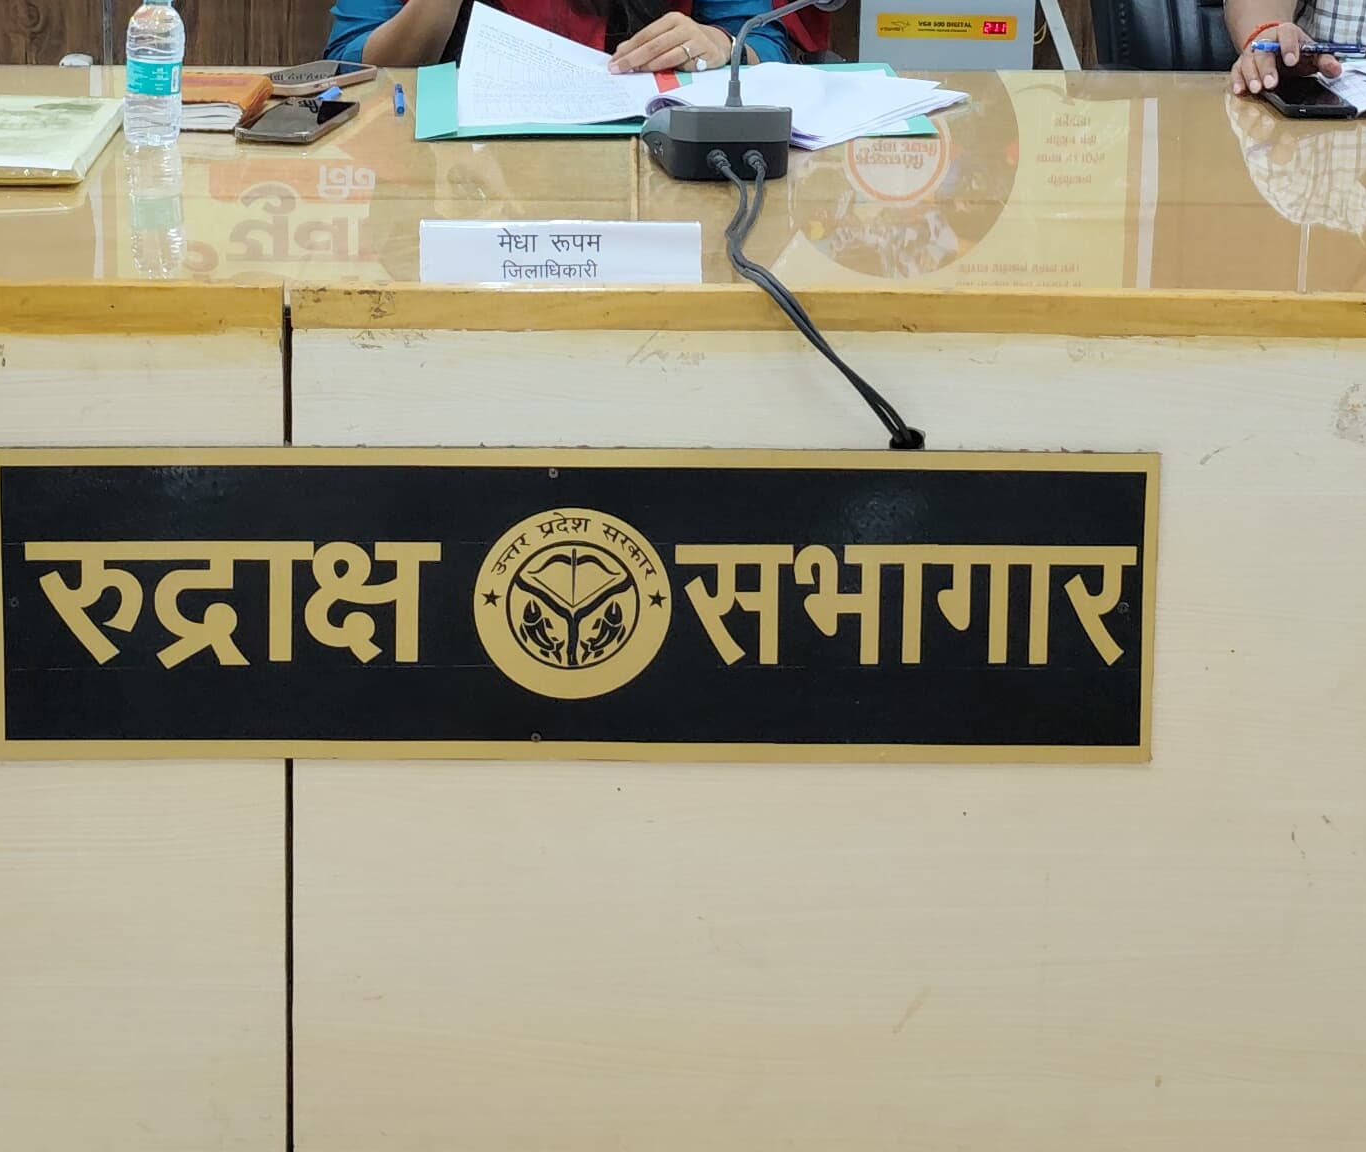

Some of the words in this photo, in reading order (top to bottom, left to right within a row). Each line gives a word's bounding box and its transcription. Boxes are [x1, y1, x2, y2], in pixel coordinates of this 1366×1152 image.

[497, 228, 538, 253] मेधा
[550, 233, 602, 253] रूपम
[502, 258, 598, 280] जिलाधिकारी
[491, 532, 531, 576] उत्तर
[536, 512, 592, 539] प्रदेश
[602, 523, 657, 581] सरकार
[24, 539, 441, 669] रुद्राक्ष
[676, 541, 1138, 668] सभागार
